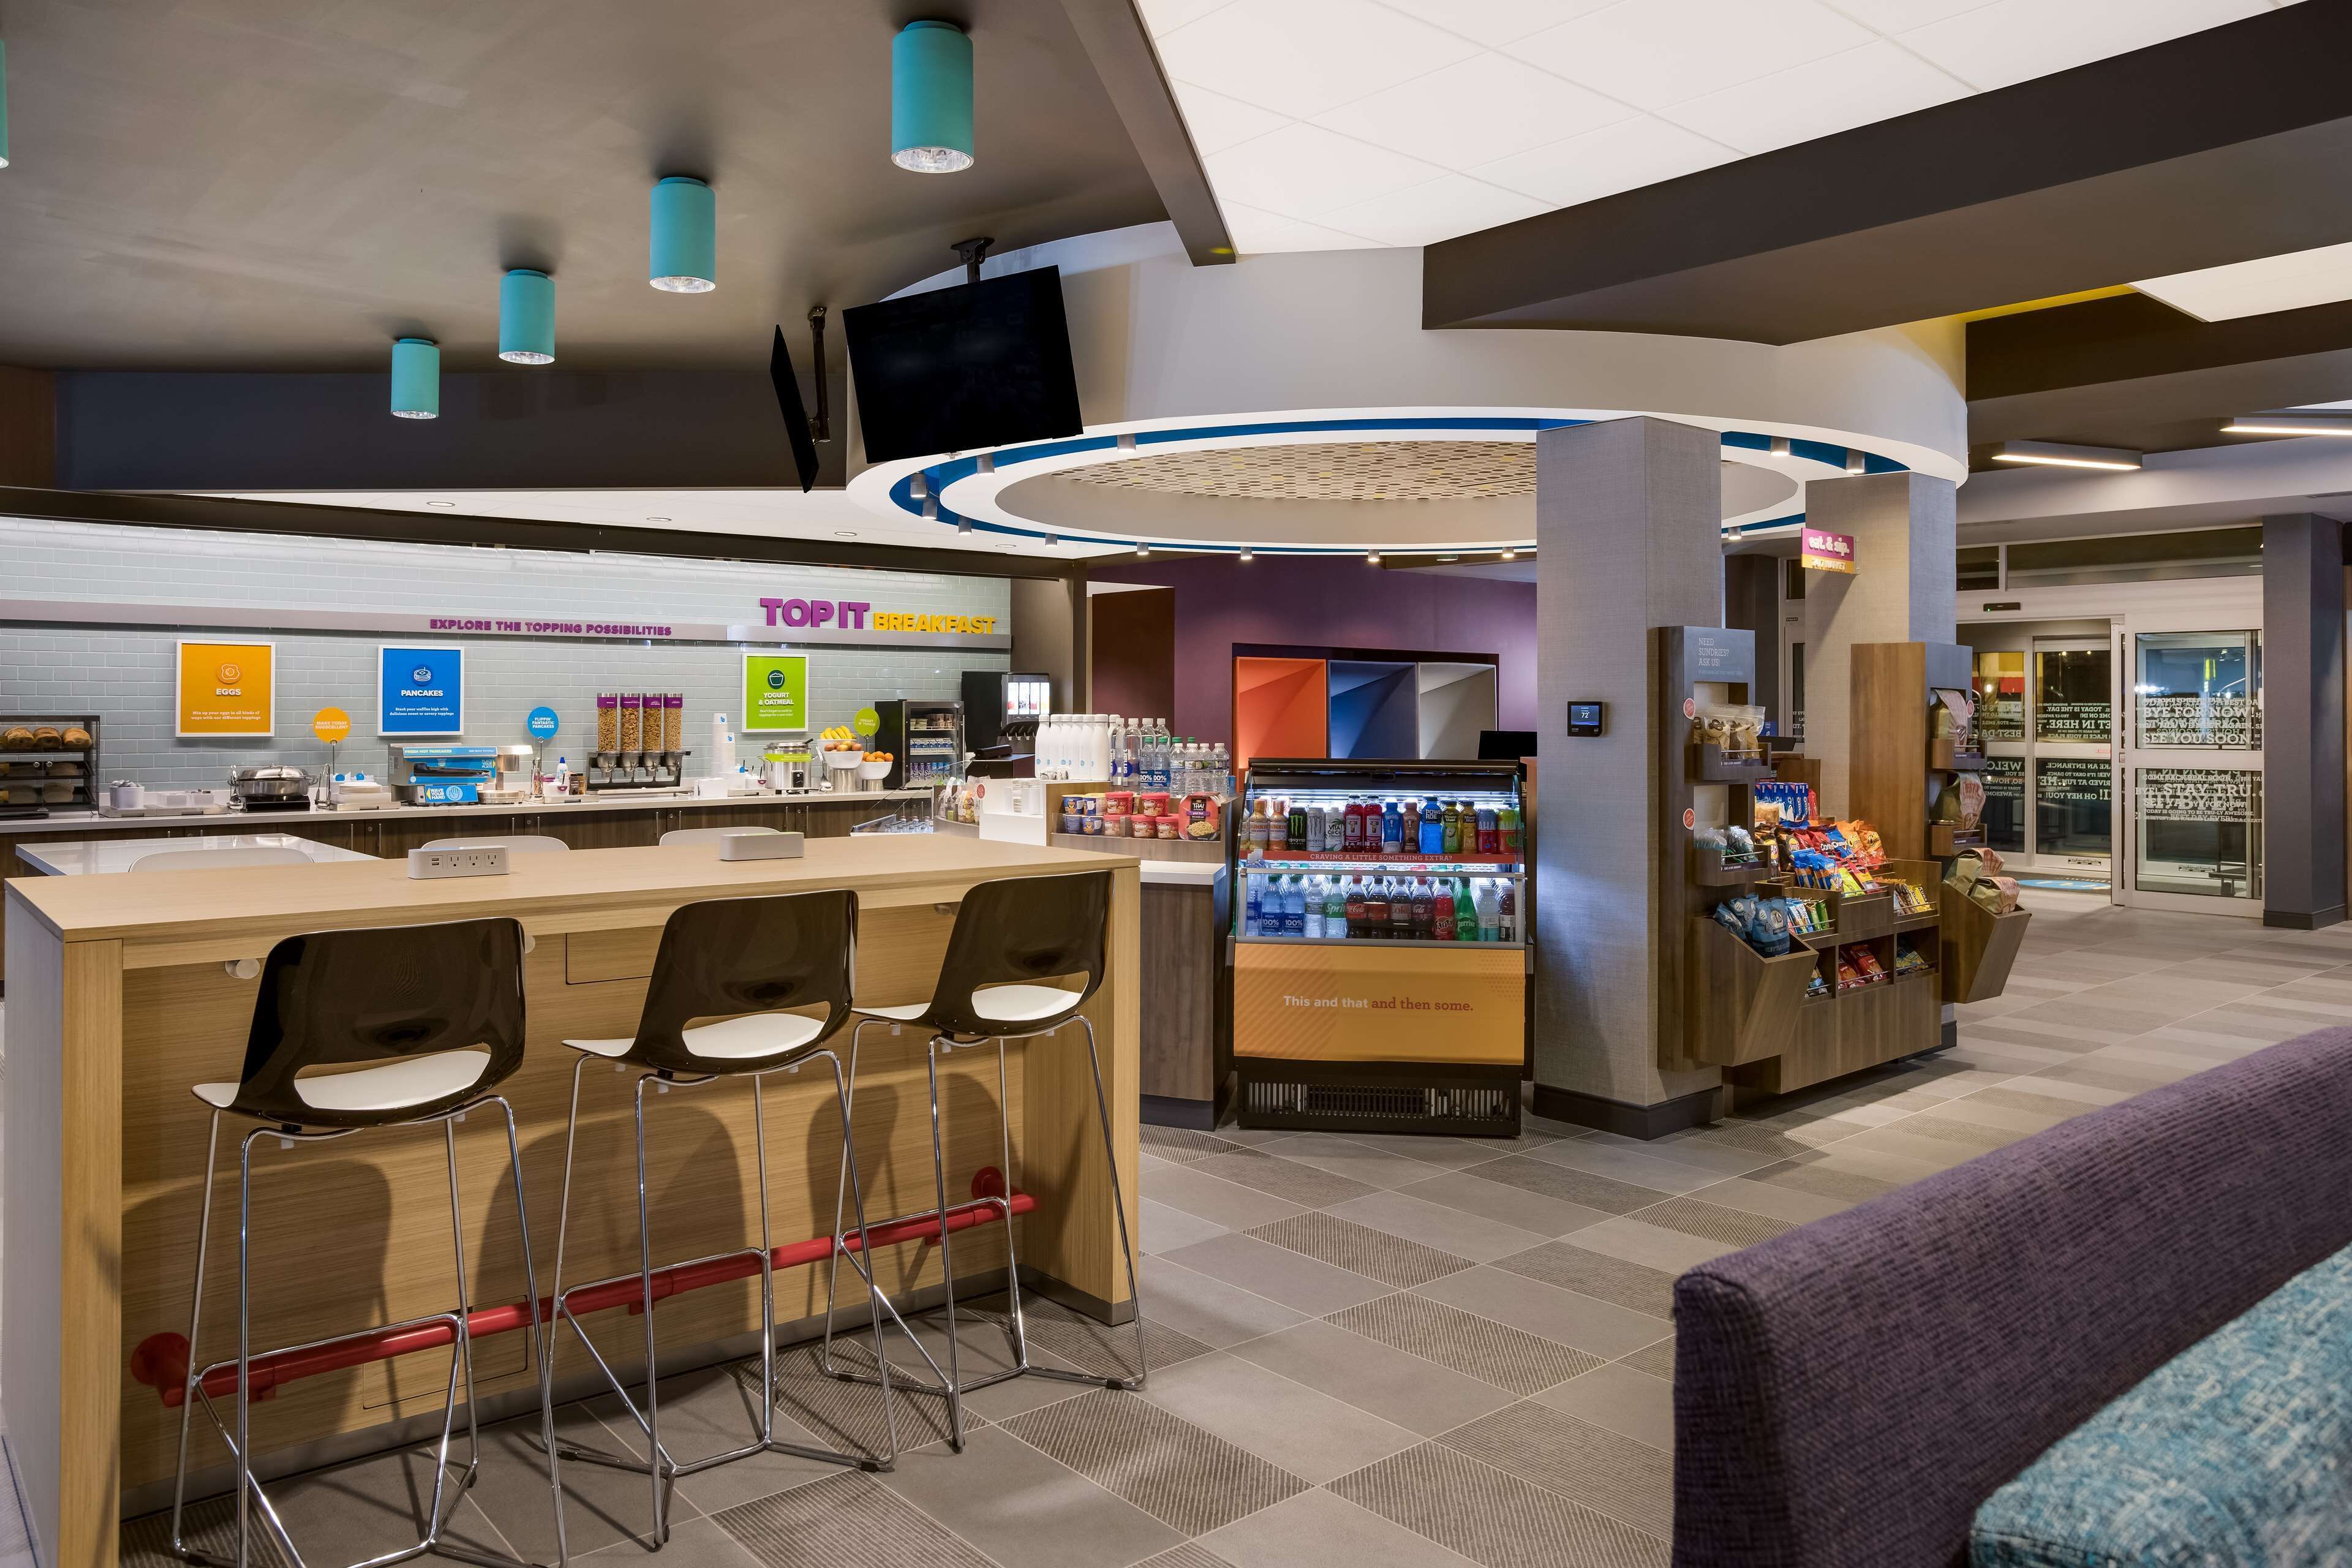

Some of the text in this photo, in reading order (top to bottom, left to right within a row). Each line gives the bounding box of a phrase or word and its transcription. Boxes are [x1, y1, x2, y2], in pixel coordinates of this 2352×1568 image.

[1826, 537, 1833, 551] &
[760, 598, 997, 634] TOP IT BREAKFAST
[430, 619, 672, 636] EXPLORE THE TOPPING POSSIBILITIES
[1698, 647, 1729, 657] SUNDRIES?
[2143, 707, 2255, 718] BYE FOR NOW!
[2143, 733, 2255, 744] SEE YOU SOON.
[2163, 783, 2207, 796] STAY
[2215, 784, 2256, 797] TRU.
[1283, 995, 1474, 1011] This and that and then some.
